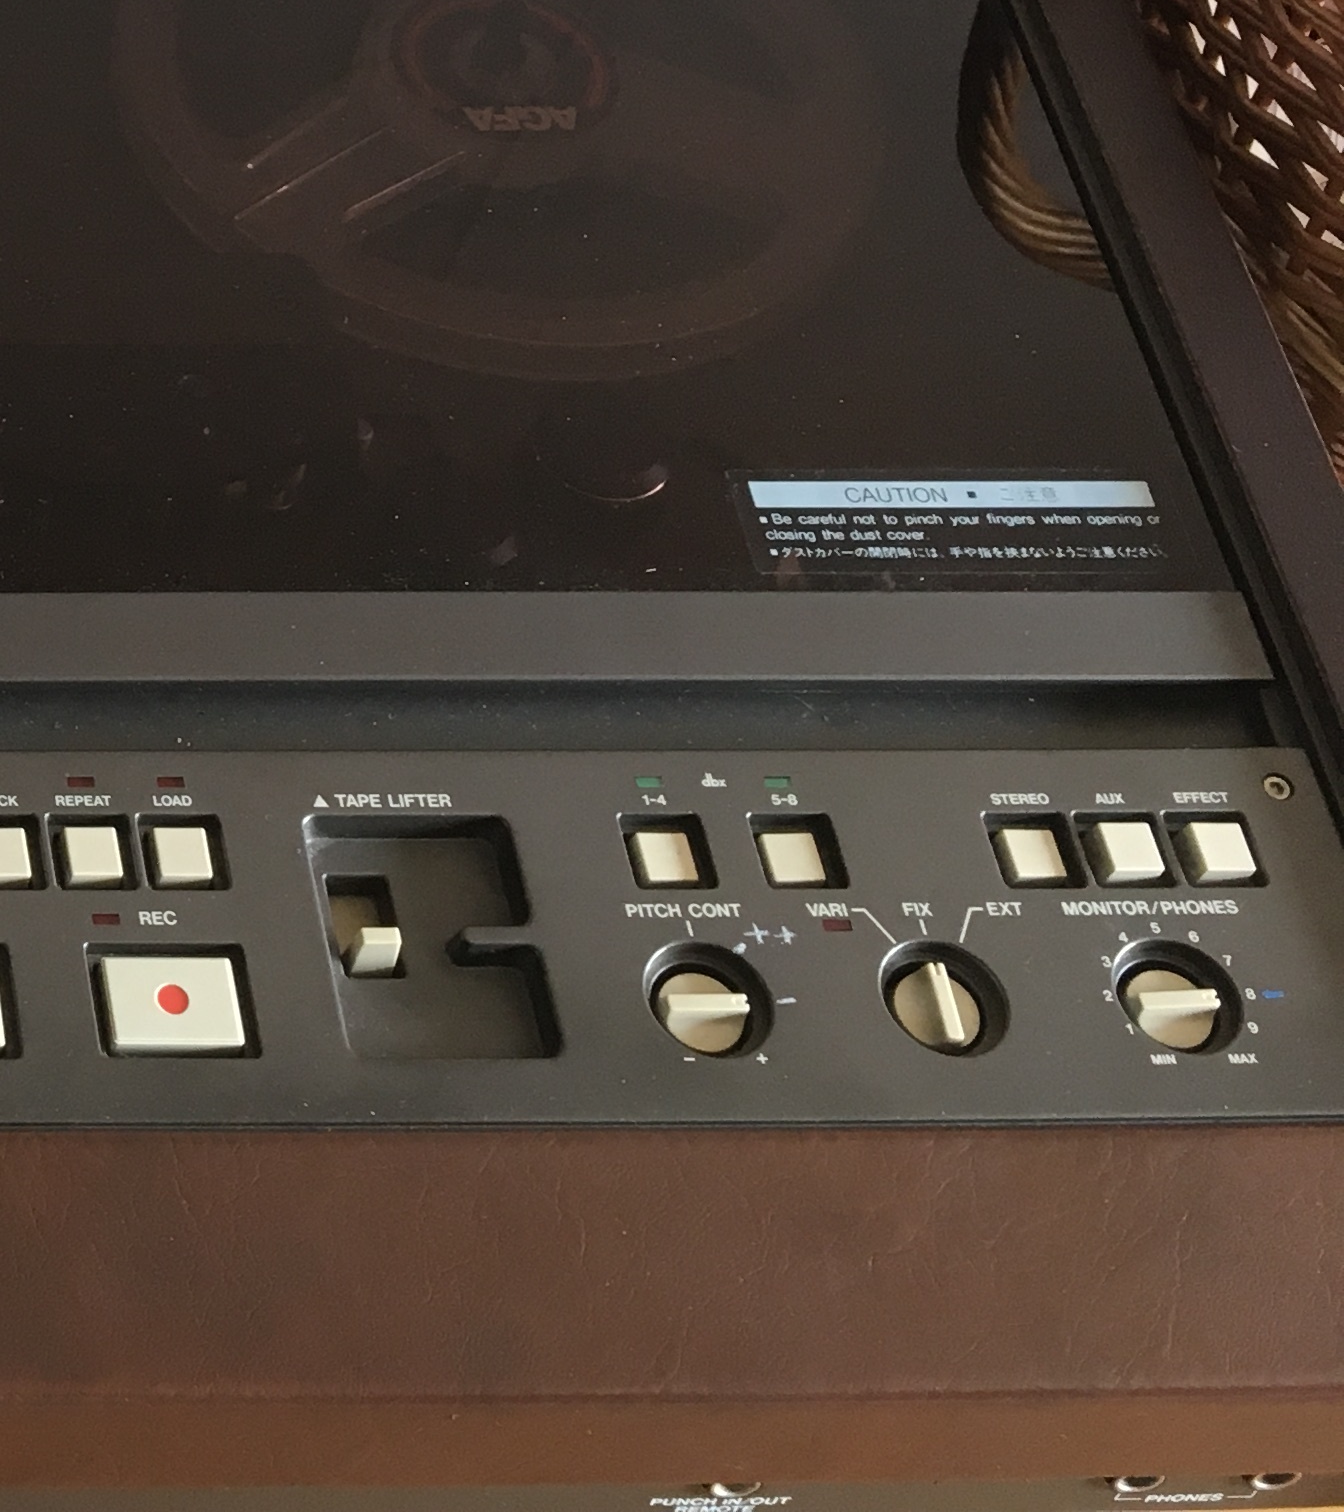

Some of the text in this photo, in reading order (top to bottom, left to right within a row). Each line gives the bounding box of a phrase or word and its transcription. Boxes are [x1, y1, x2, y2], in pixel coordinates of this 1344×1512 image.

[844, 487, 948, 503] CAUTION
[771, 513, 1161, 529] Be careful not to pinch your fingers when opening or
[766, 529, 817, 543] closing
[822, 529, 845, 542] the
[850, 529, 882, 542] dust
[55, 795, 111, 806] REPEAT
[153, 795, 192, 806] LOAD
[334, 794, 452, 807] TAPE LIFTER
[642, 795, 666, 805] 1-4
[771, 794, 798, 805] 5-8
[990, 793, 1049, 805] STEREO
[1096, 793, 1125, 804] AUX
[1173, 792, 1227, 803] EFFECT
[625, 903, 740, 918] PITCH CONT
[806, 903, 848, 917] VARI
[902, 903, 933, 916] FIX
[986, 902, 1021, 915] EXT
[1061, 900, 1239, 915] MONITOR/PHONES
[139, 911, 177, 925] REC
[1150, 1054, 1177, 1065] MIN
[1228, 1053, 1258, 1063] MAX
[649, 1497, 718, 1506] PUNCH
[1144, 1493, 1224, 1502] PHONES
